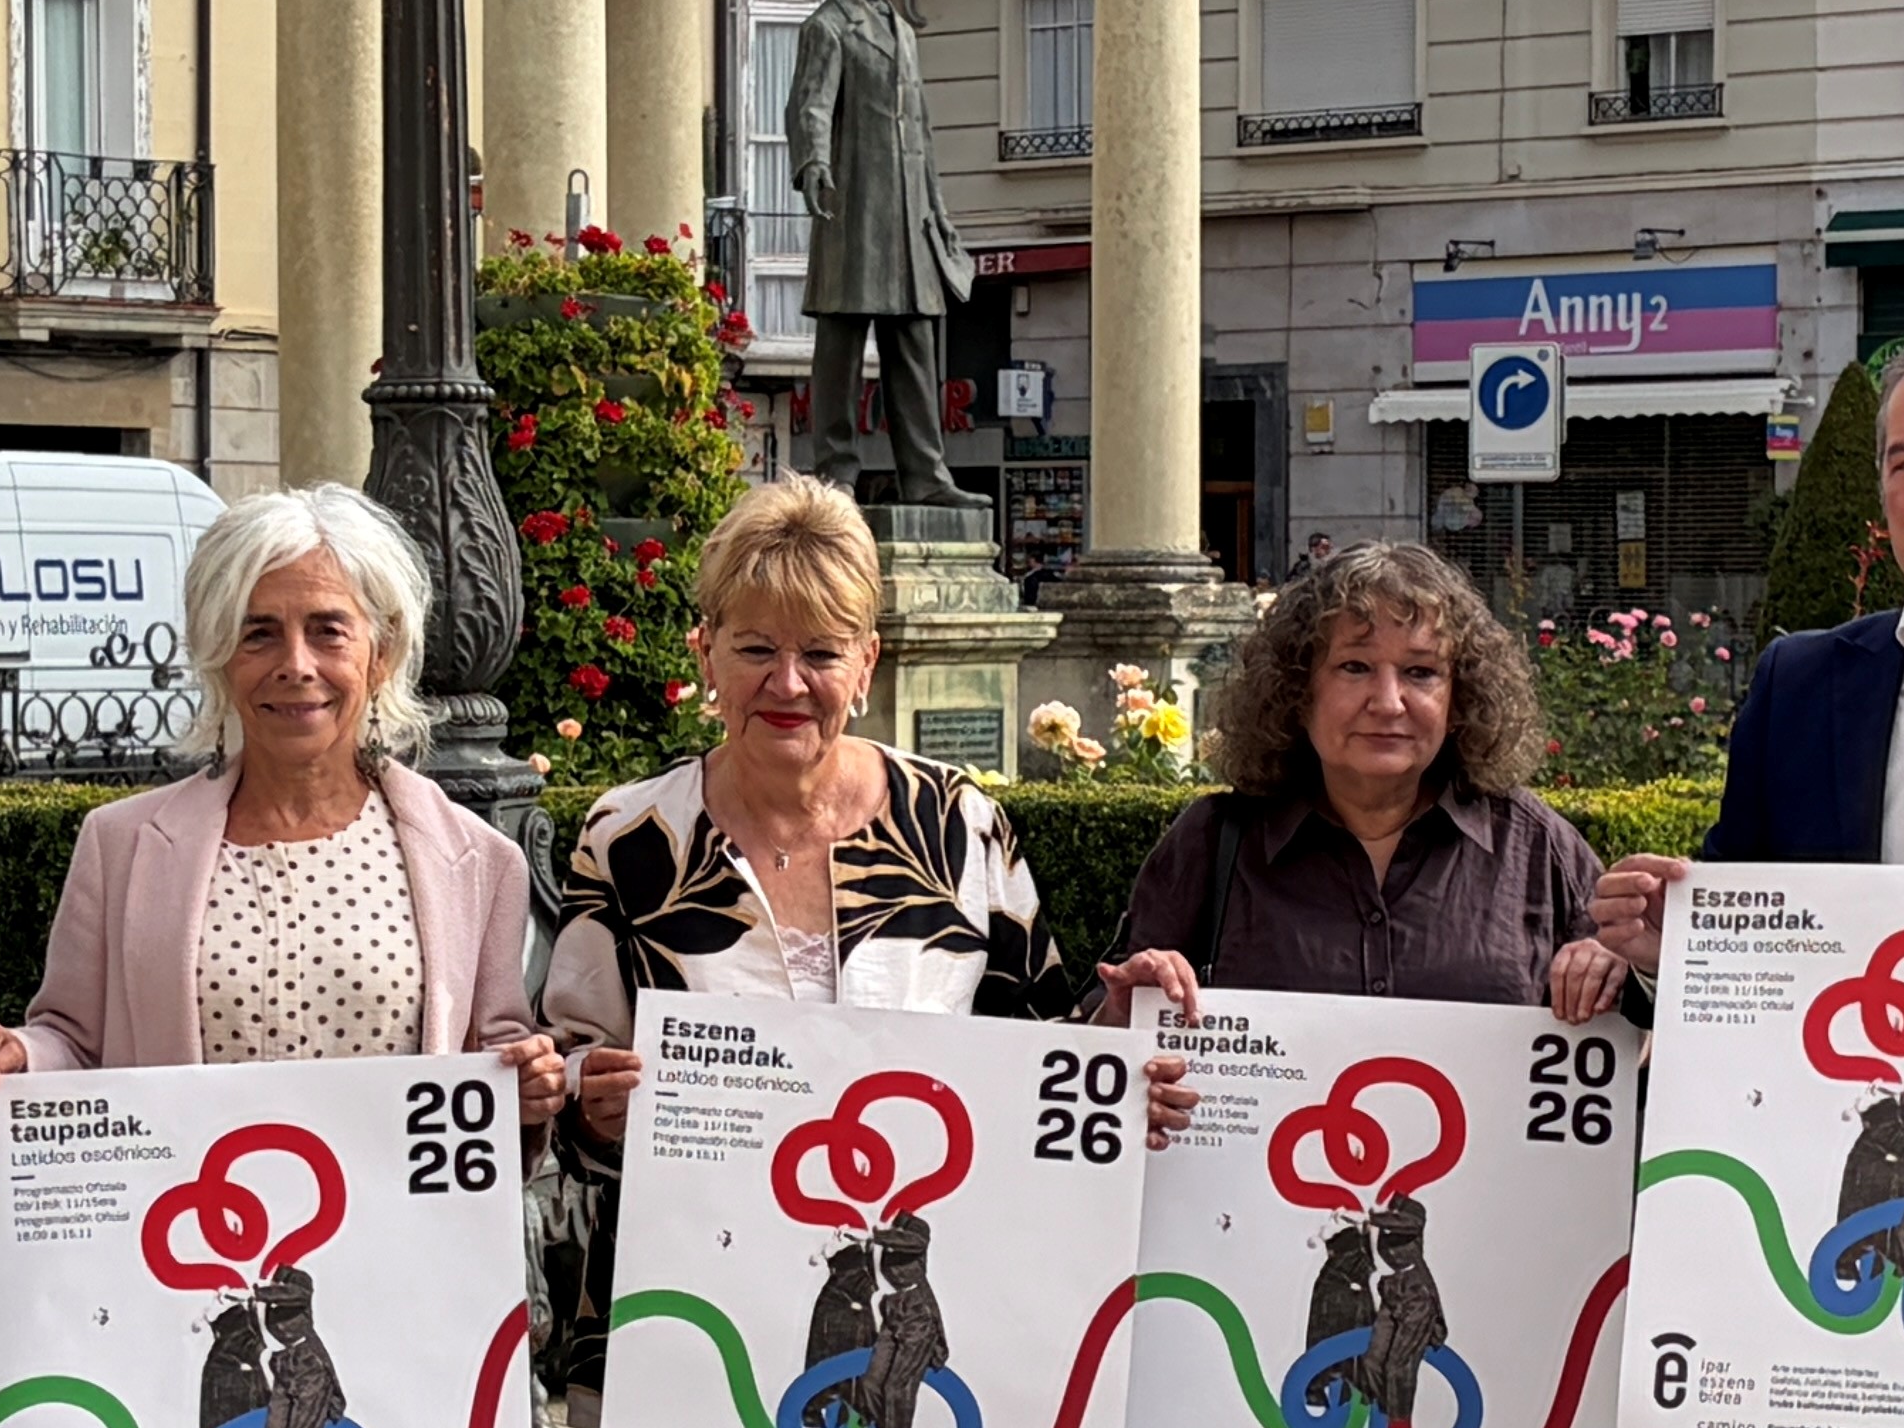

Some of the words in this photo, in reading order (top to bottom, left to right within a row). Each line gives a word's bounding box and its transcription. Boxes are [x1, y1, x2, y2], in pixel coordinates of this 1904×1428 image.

[973, 251, 1016, 275] ER
[1518, 278, 1641, 353] Anny
[1648, 295, 1669, 331] 2
[9, 620, 19, 638] y
[23, 613, 128, 635] Rehabilitación
[1692, 888, 1785, 907] Eszena
[1691, 909, 1823, 935] taupadak.
[1687, 938, 1748, 953] Latidos
[663, 1017, 755, 1043] Eszena
[1158, 1009, 1249, 1031] Esena
[660, 1040, 793, 1069] taupadak.
[1157, 1031, 1286, 1057] taupadak.
[1530, 1034, 1616, 1088] 20
[658, 1070, 718, 1086] Latidos
[1038, 1050, 1128, 1106] 20
[10, 1098, 109, 1119] Eszena
[406, 1080, 495, 1135] 20
[1526, 1091, 1612, 1145] 26
[11, 1116, 151, 1145] taupadak.
[1034, 1107, 1123, 1164] 26
[11, 1150, 74, 1166] Latidos
[408, 1139, 497, 1194] 26
